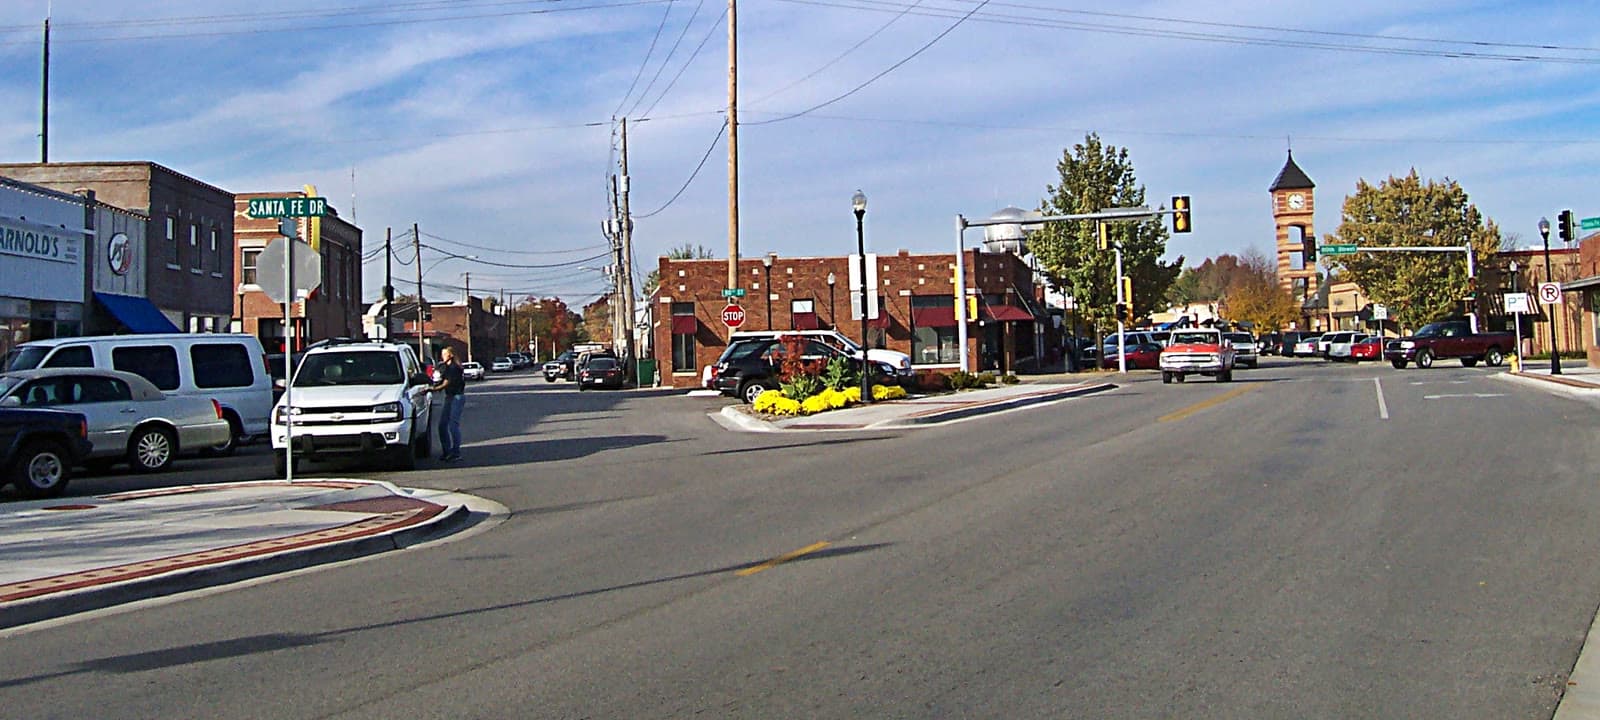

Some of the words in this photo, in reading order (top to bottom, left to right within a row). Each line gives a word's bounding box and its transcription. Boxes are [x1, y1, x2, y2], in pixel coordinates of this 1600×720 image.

[251, 200, 285, 216] SANTA
[291, 200, 304, 215] FE
[309, 199, 324, 215] DR
[723, 311, 744, 321] STOP
